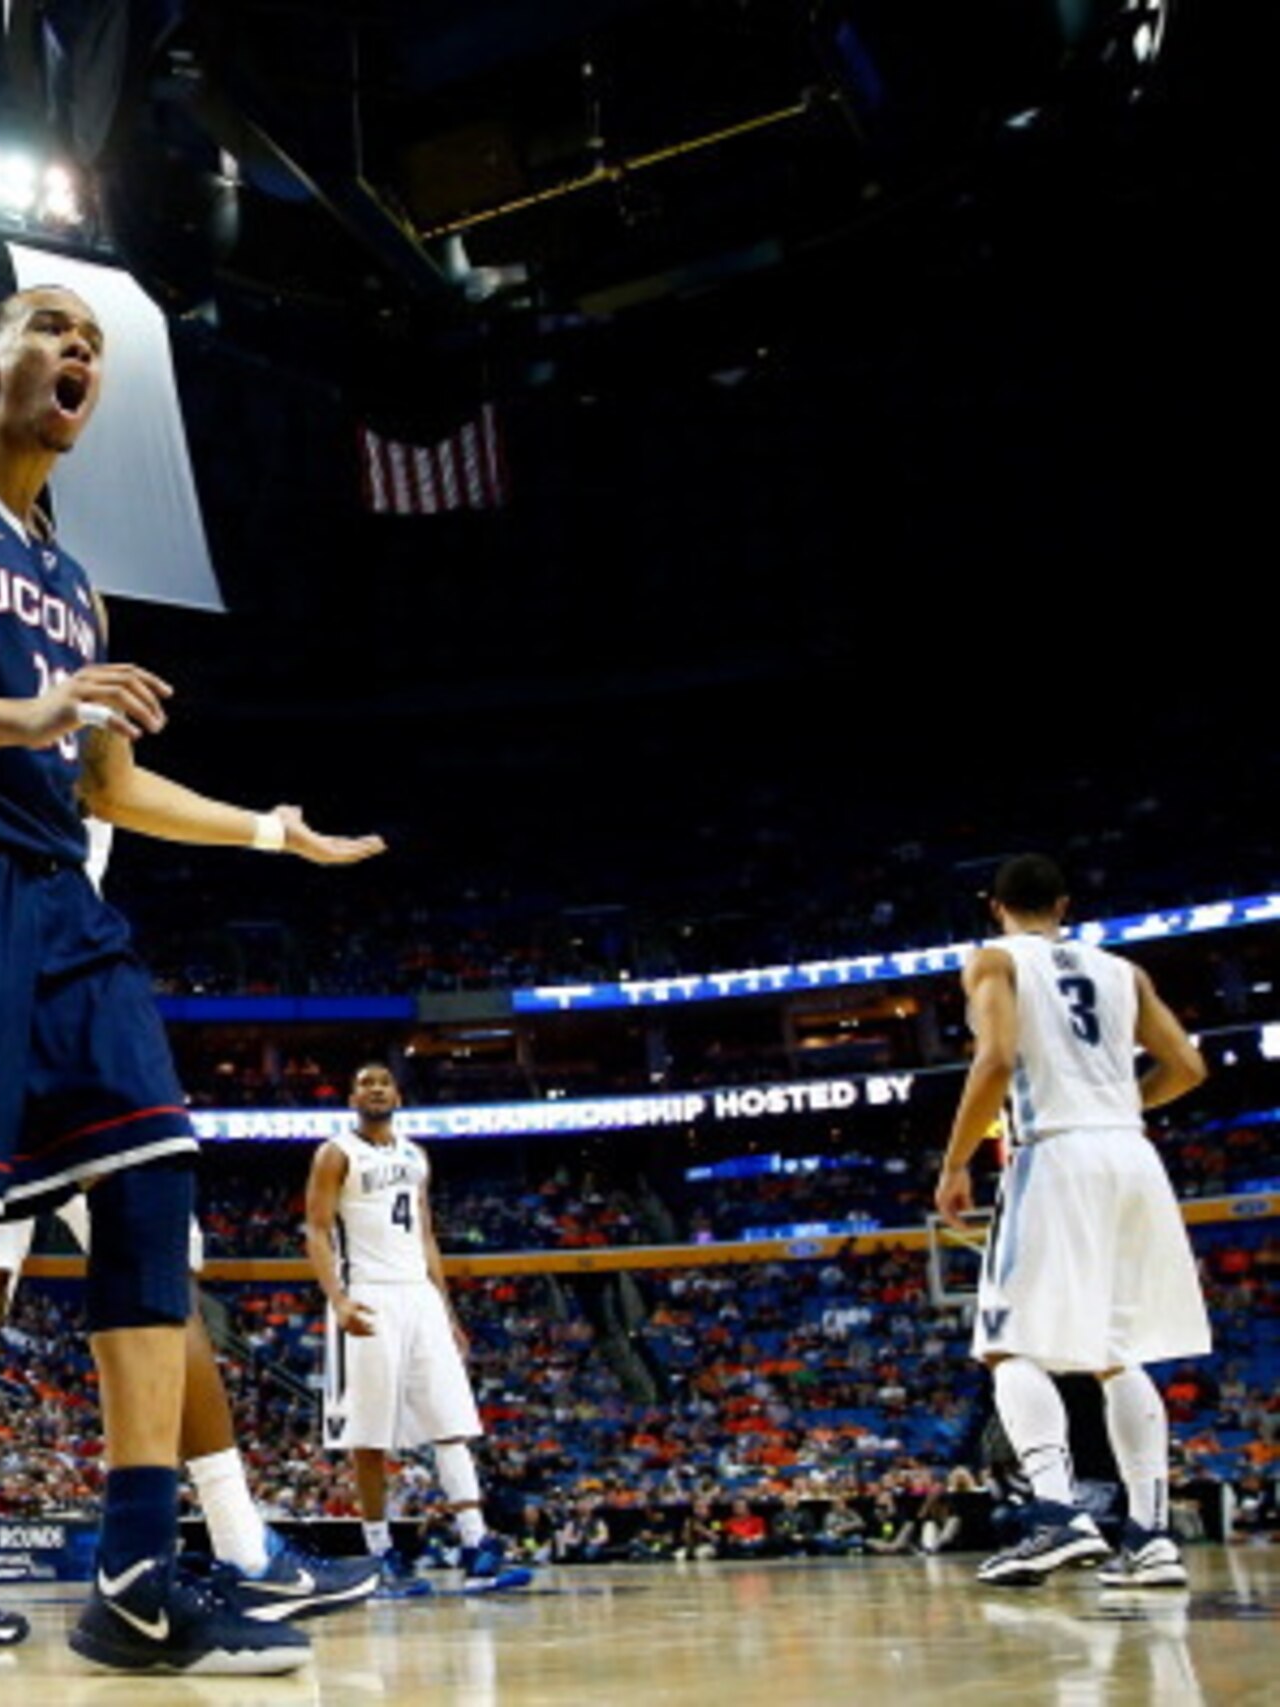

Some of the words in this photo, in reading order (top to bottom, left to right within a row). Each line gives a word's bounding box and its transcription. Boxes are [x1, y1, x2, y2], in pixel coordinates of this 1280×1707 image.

[1056, 974, 1100, 1048] 3
[452, 1094, 707, 1134] CHAMPIONSHIP
[714, 1080, 858, 1119] HOSTED
[865, 1074, 914, 1105] BY
[391, 1191, 412, 1232] 4
[0, 1526, 64, 1548] ROUNDS
